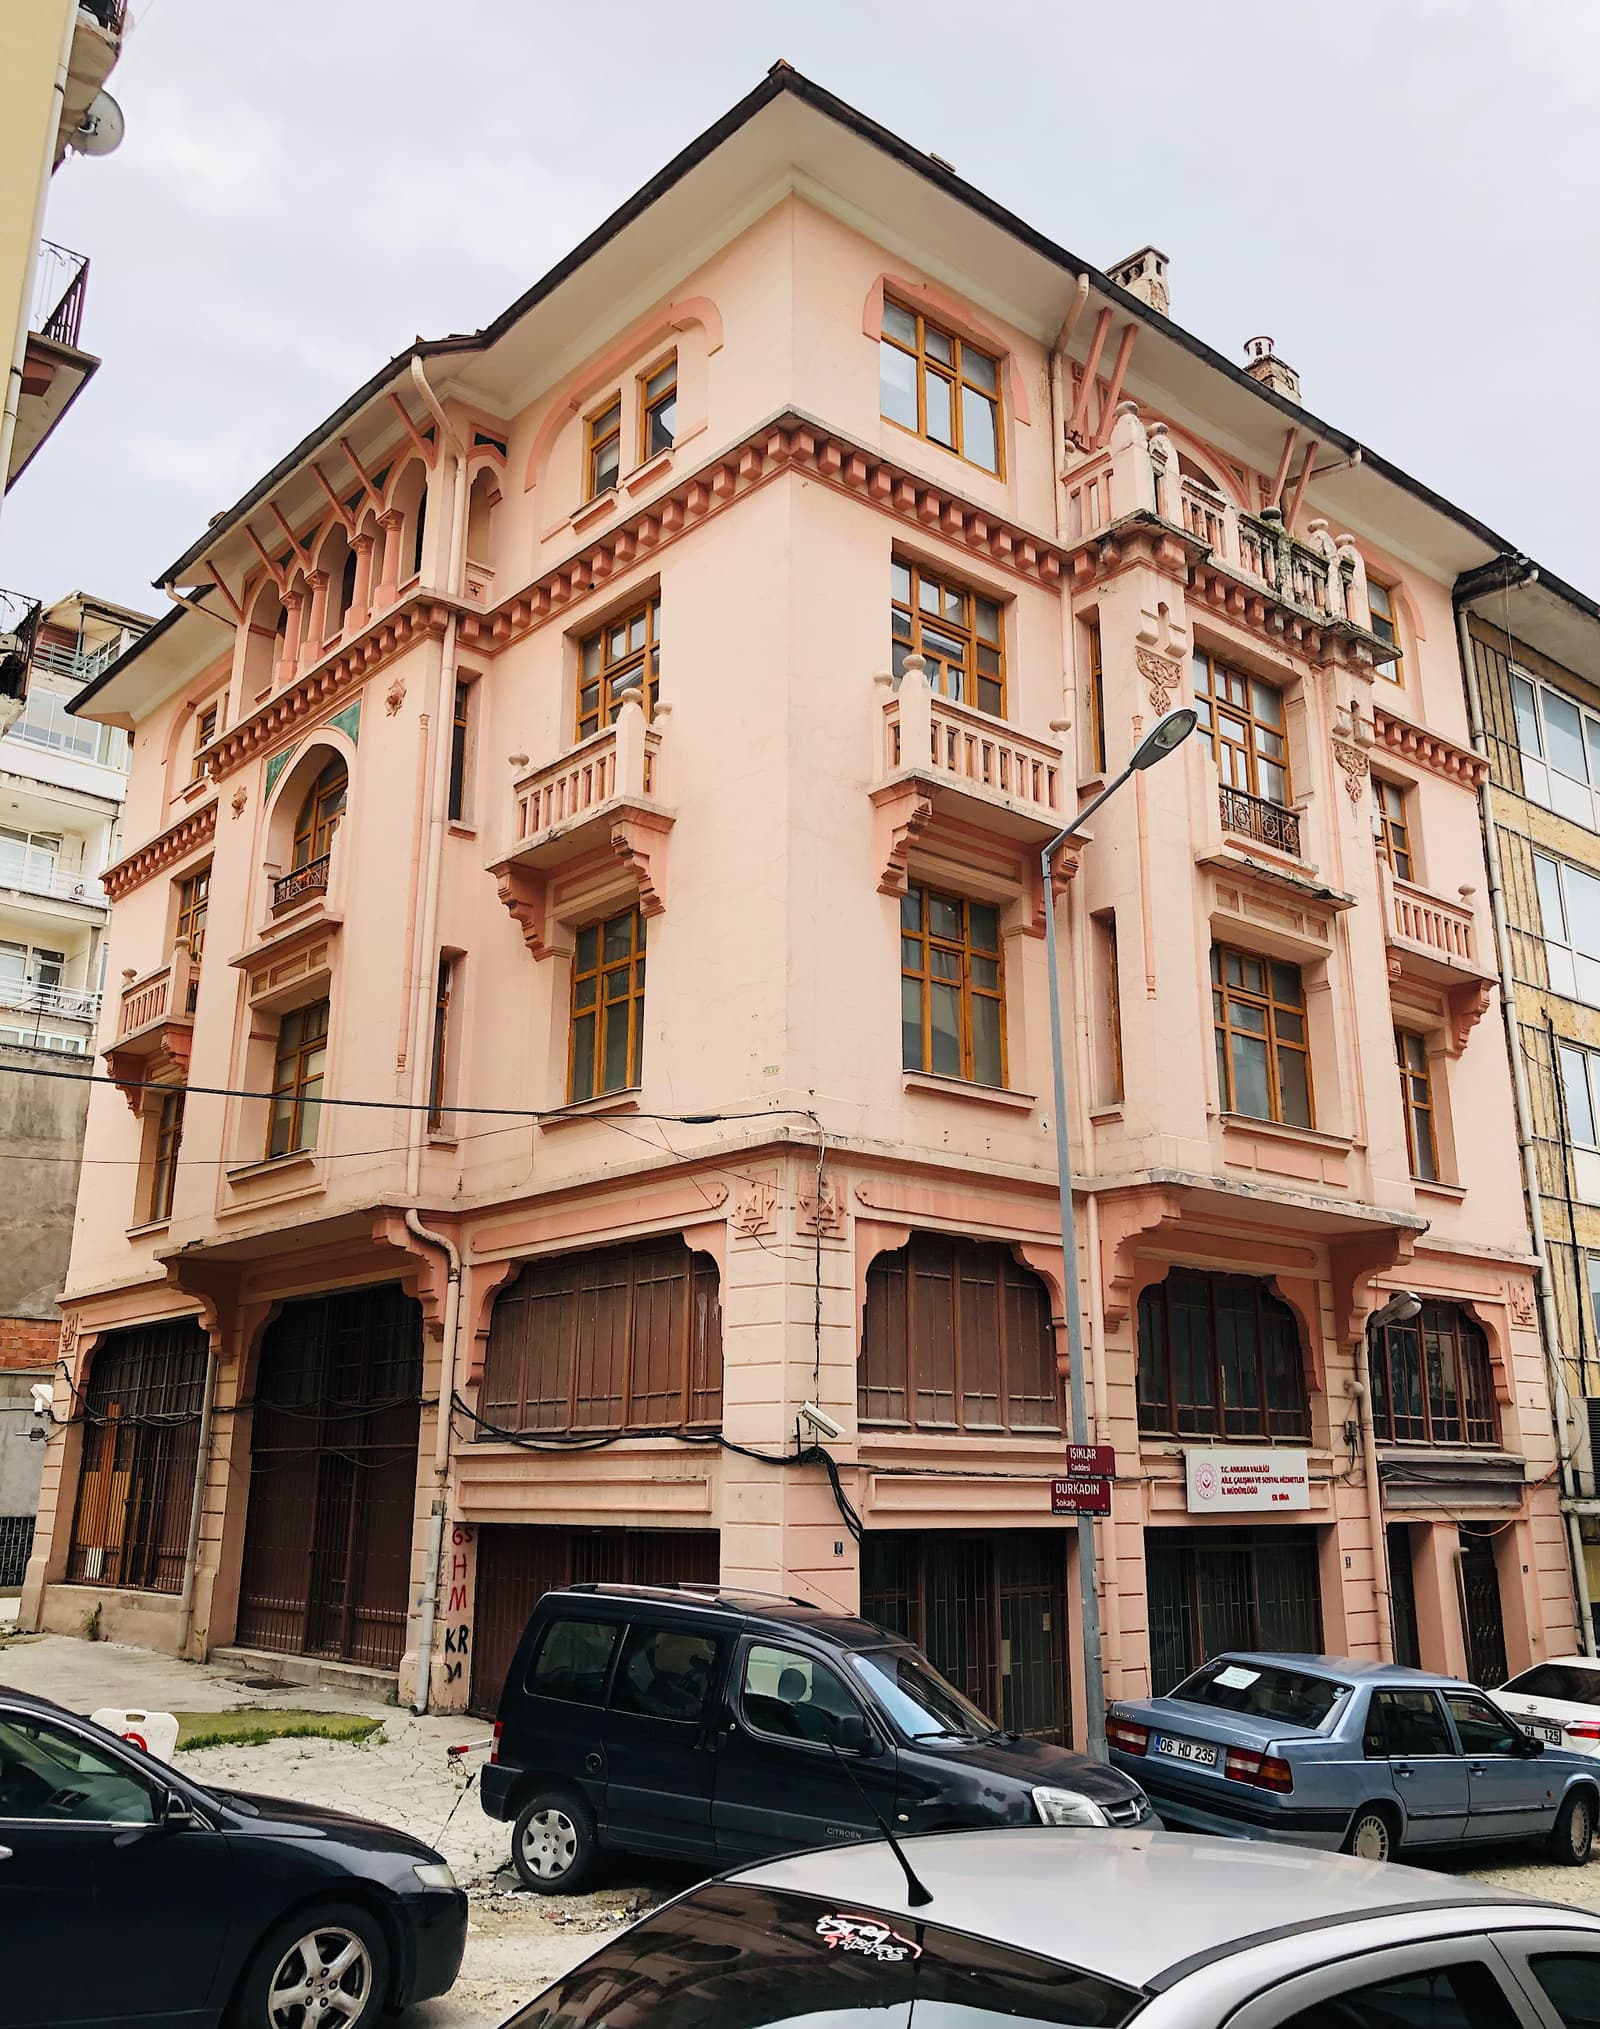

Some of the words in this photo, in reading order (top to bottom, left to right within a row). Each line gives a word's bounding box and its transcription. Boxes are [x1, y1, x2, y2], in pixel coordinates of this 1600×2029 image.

[1070, 1448, 1096, 1460] IŞIKLAR
[1071, 1464, 1090, 1472] Caddesi
[1230, 1465, 1250, 1473] ANKARA
[1056, 1483, 1100, 1495] DURKADIN
[1544, 1729, 1559, 1741] 125
[1160, 1738, 1174, 1753] 06
[1178, 1742, 1192, 1757] HD
[1194, 1746, 1215, 1763] 235
